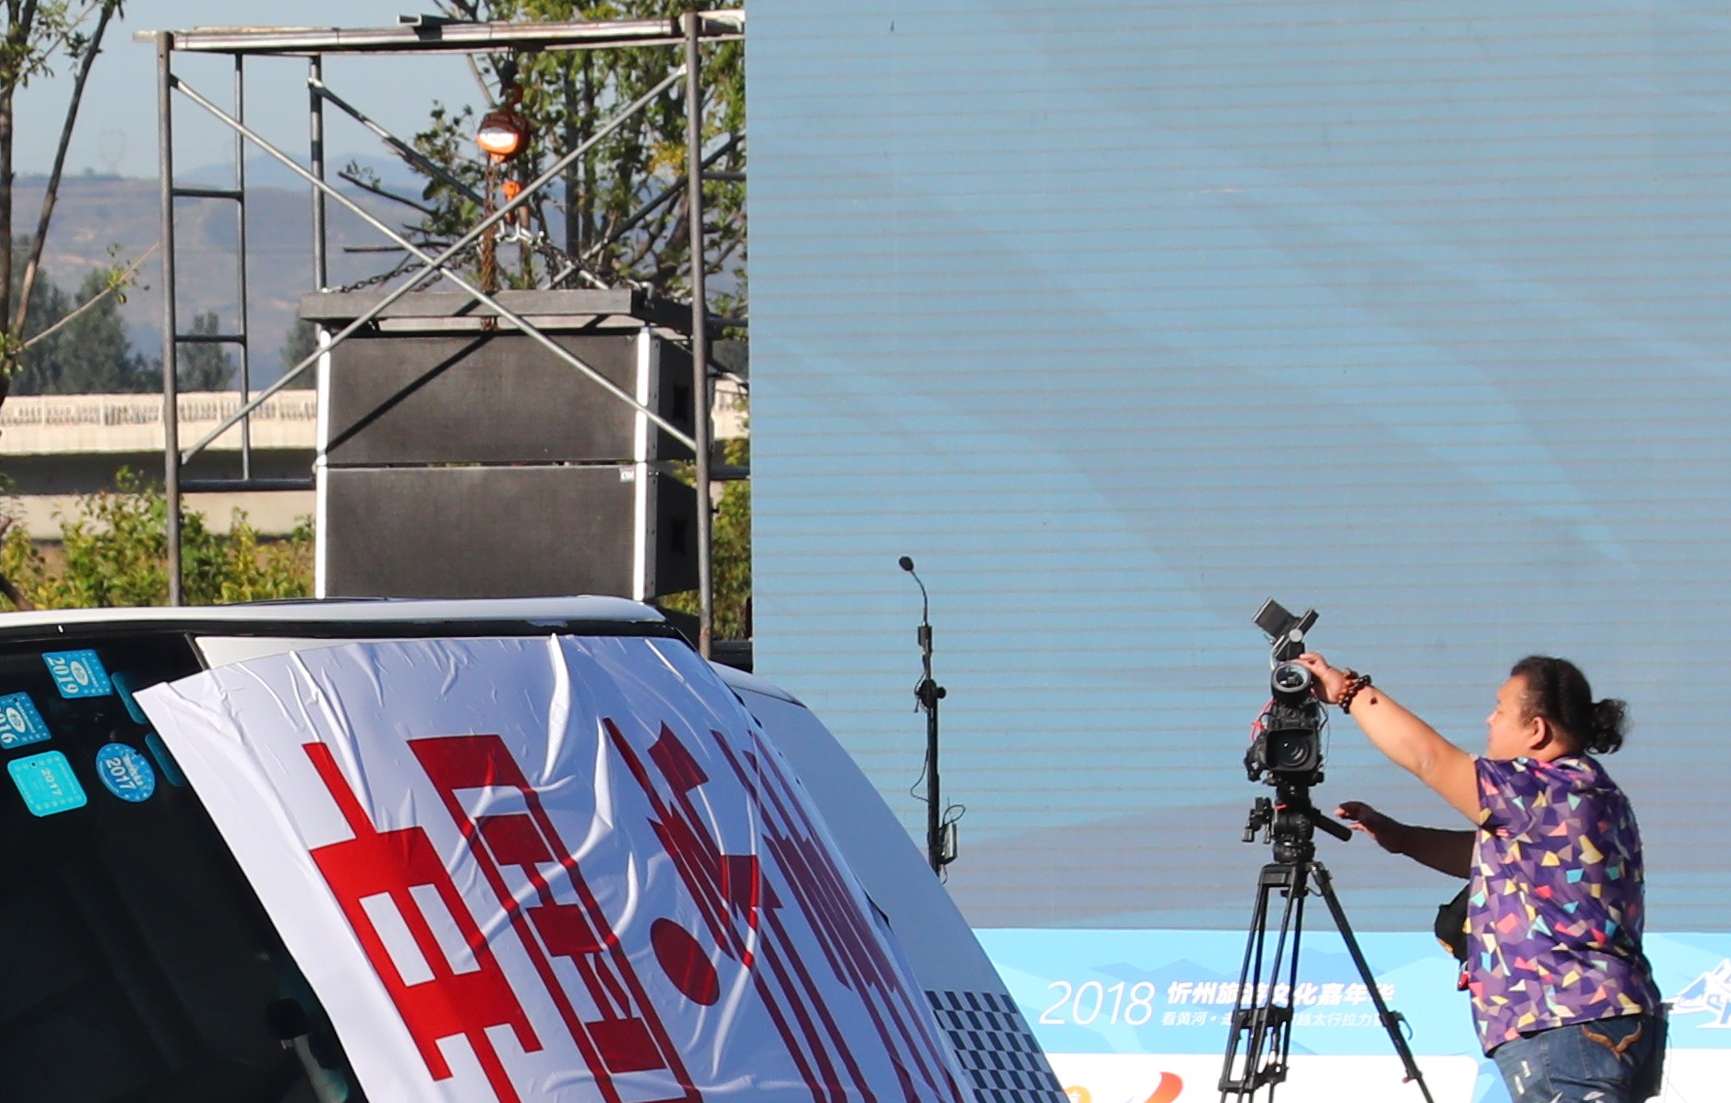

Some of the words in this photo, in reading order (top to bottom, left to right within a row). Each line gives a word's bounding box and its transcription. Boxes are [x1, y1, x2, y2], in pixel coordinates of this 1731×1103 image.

[40, 768, 63, 796] 2017
[105, 757, 137, 791] 2017
[1039, 980, 1156, 1026] 2018
